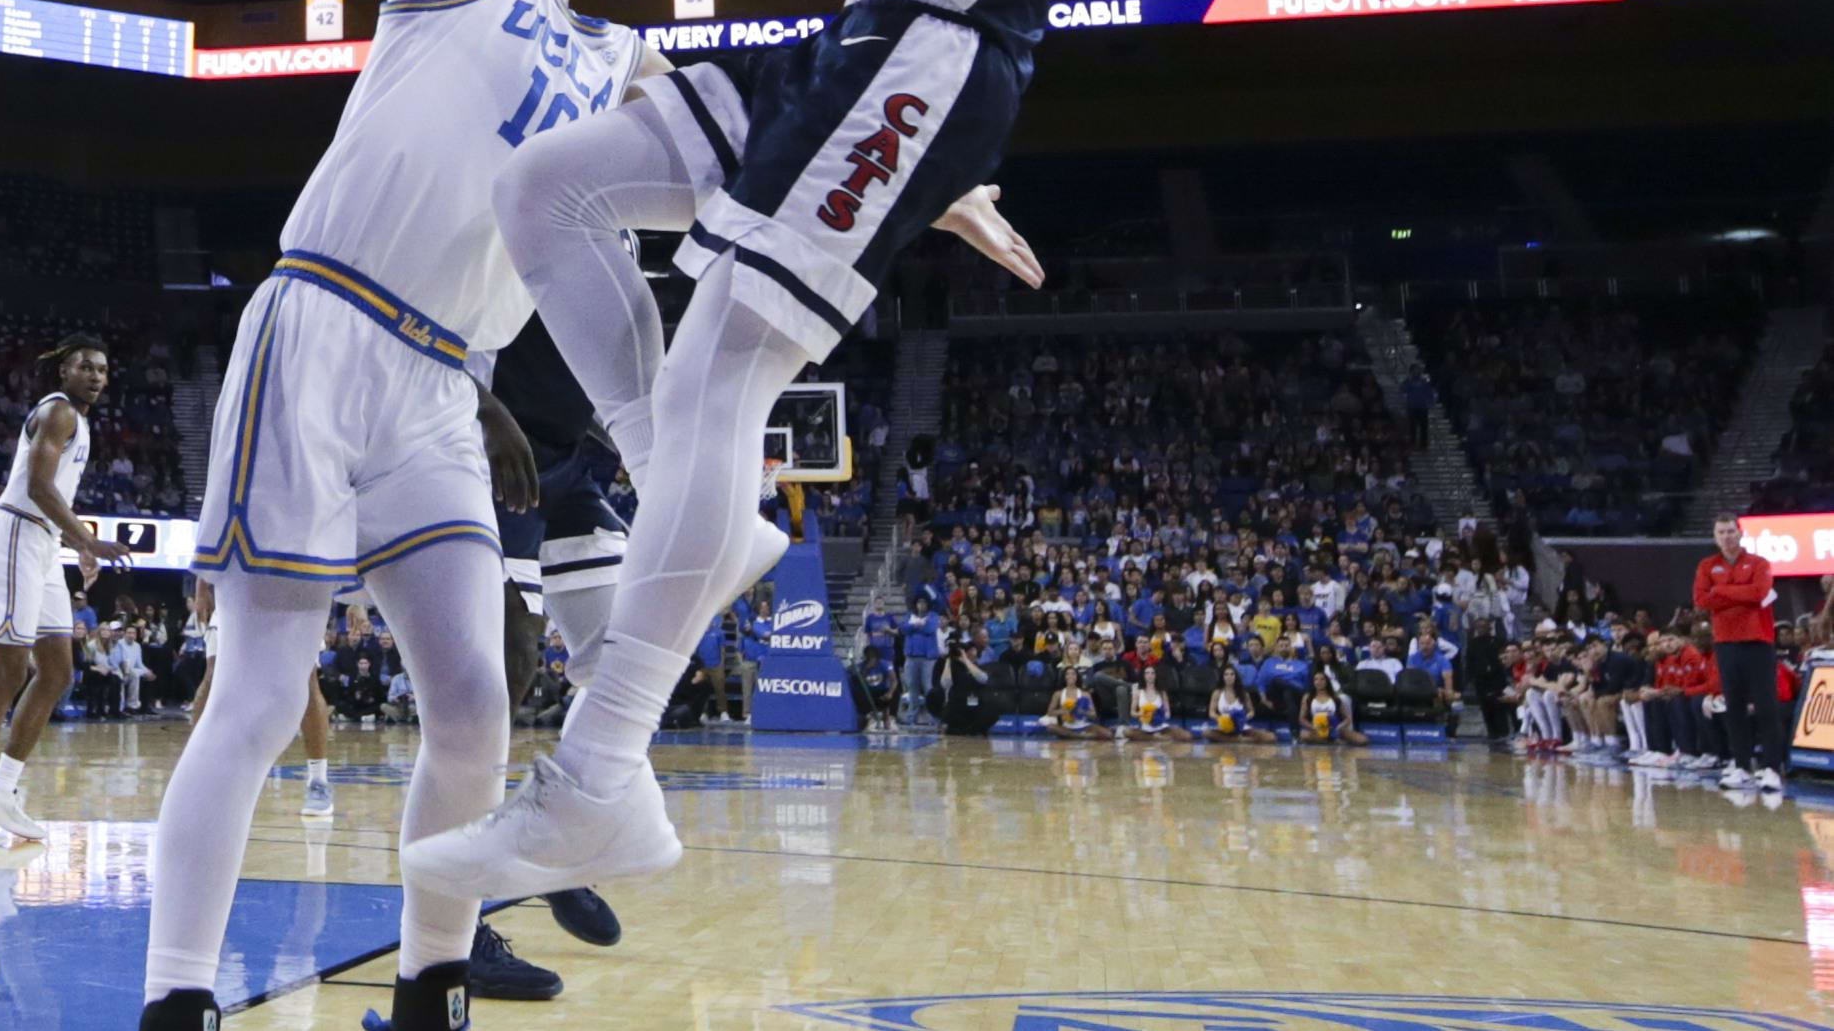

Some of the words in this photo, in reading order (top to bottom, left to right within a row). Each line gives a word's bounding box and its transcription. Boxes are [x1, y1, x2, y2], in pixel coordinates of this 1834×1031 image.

[316, 11, 335, 26] 42
[645, 23, 724, 51] EVERY
[1048, 0, 1141, 29] CABLE
[198, 46, 354, 77] FUBOTV.COM
[501, 0, 614, 115] UCLA
[816, 93, 930, 232] CATS
[128, 524, 144, 545] 7
[770, 635, 824, 650] READY
[758, 678, 824, 696] WESCOM
